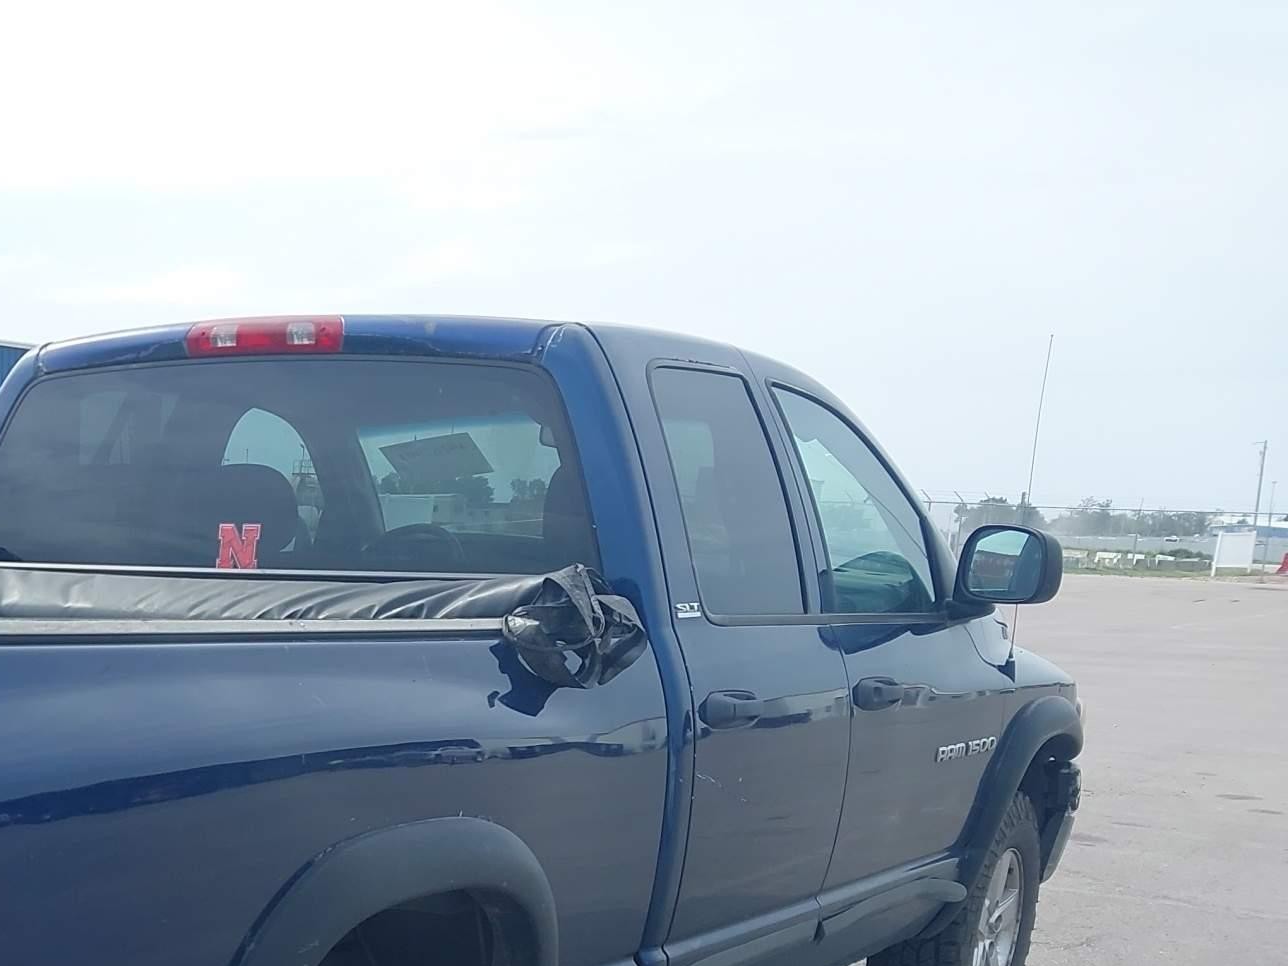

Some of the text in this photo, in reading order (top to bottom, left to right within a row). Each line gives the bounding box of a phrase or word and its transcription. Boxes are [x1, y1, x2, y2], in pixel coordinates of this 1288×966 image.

[216, 523, 261, 569] N
[936, 736, 997, 762] RAM 1500
